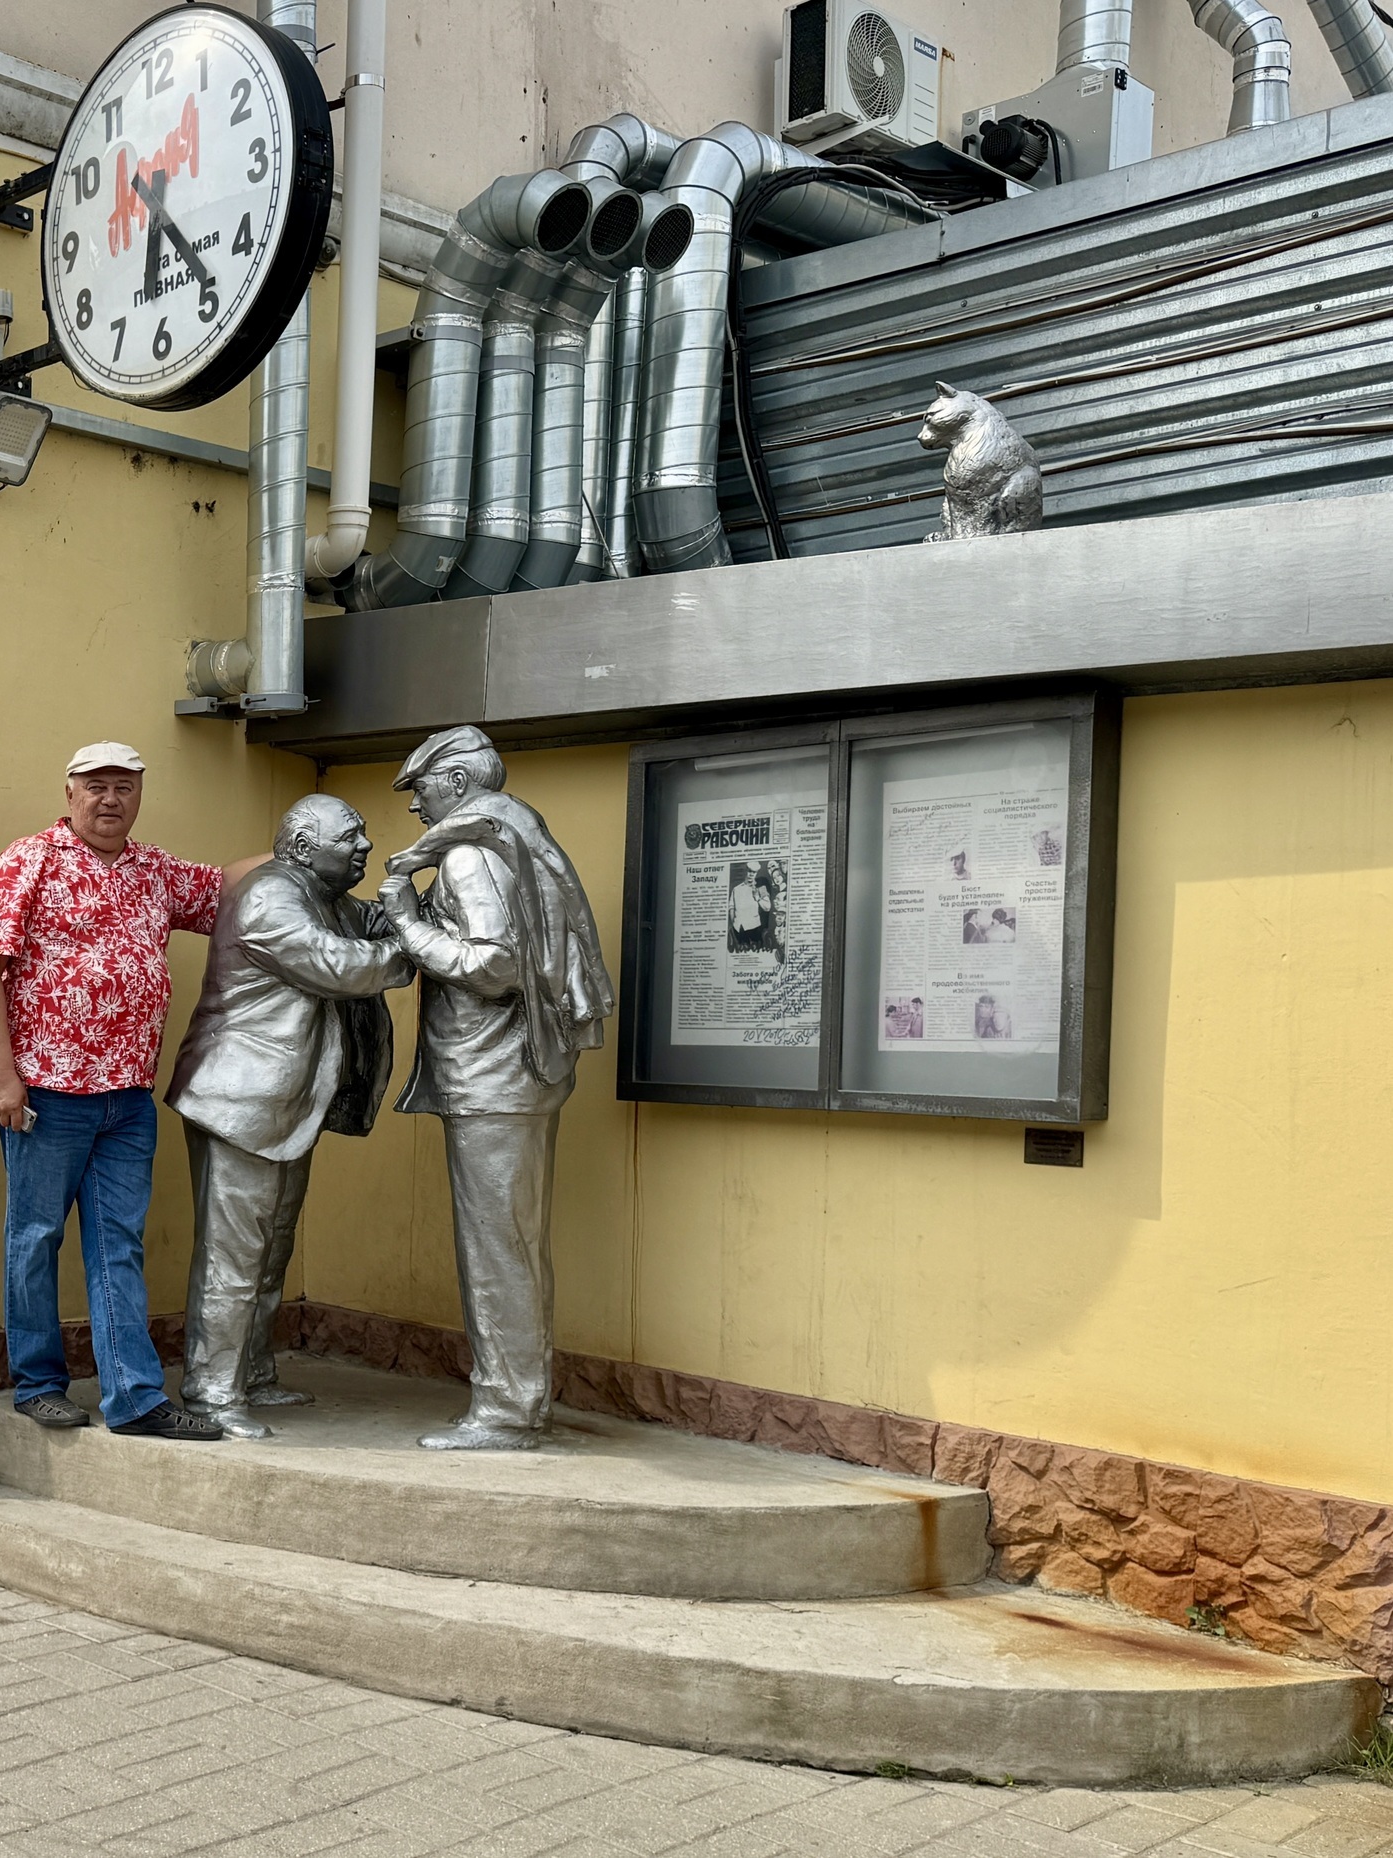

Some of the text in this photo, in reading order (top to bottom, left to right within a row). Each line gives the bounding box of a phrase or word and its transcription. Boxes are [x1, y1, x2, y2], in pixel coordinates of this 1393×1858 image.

[141, 47, 175, 100] 12
[195, 47, 208, 92] 1
[101, 96, 124, 145] 11
[230, 78, 253, 128] 2
[70, 156, 100, 206] 10
[247, 137, 269, 184] 3
[61, 230, 79, 275] 9
[174, 230, 220, 263] смая
[231, 211, 254, 258] 4
[76, 287, 93, 331] 8
[134, 269, 195, 308] ПВНАЯ
[198, 276, 220, 323] 5
[110, 316, 126, 363] 7
[152, 316, 172, 361] 6
[701, 817, 770, 832] СЕВЕРНЫЙ
[701, 827, 770, 849] РАБОЧИЙ
[692, 875, 718, 883] Западу
